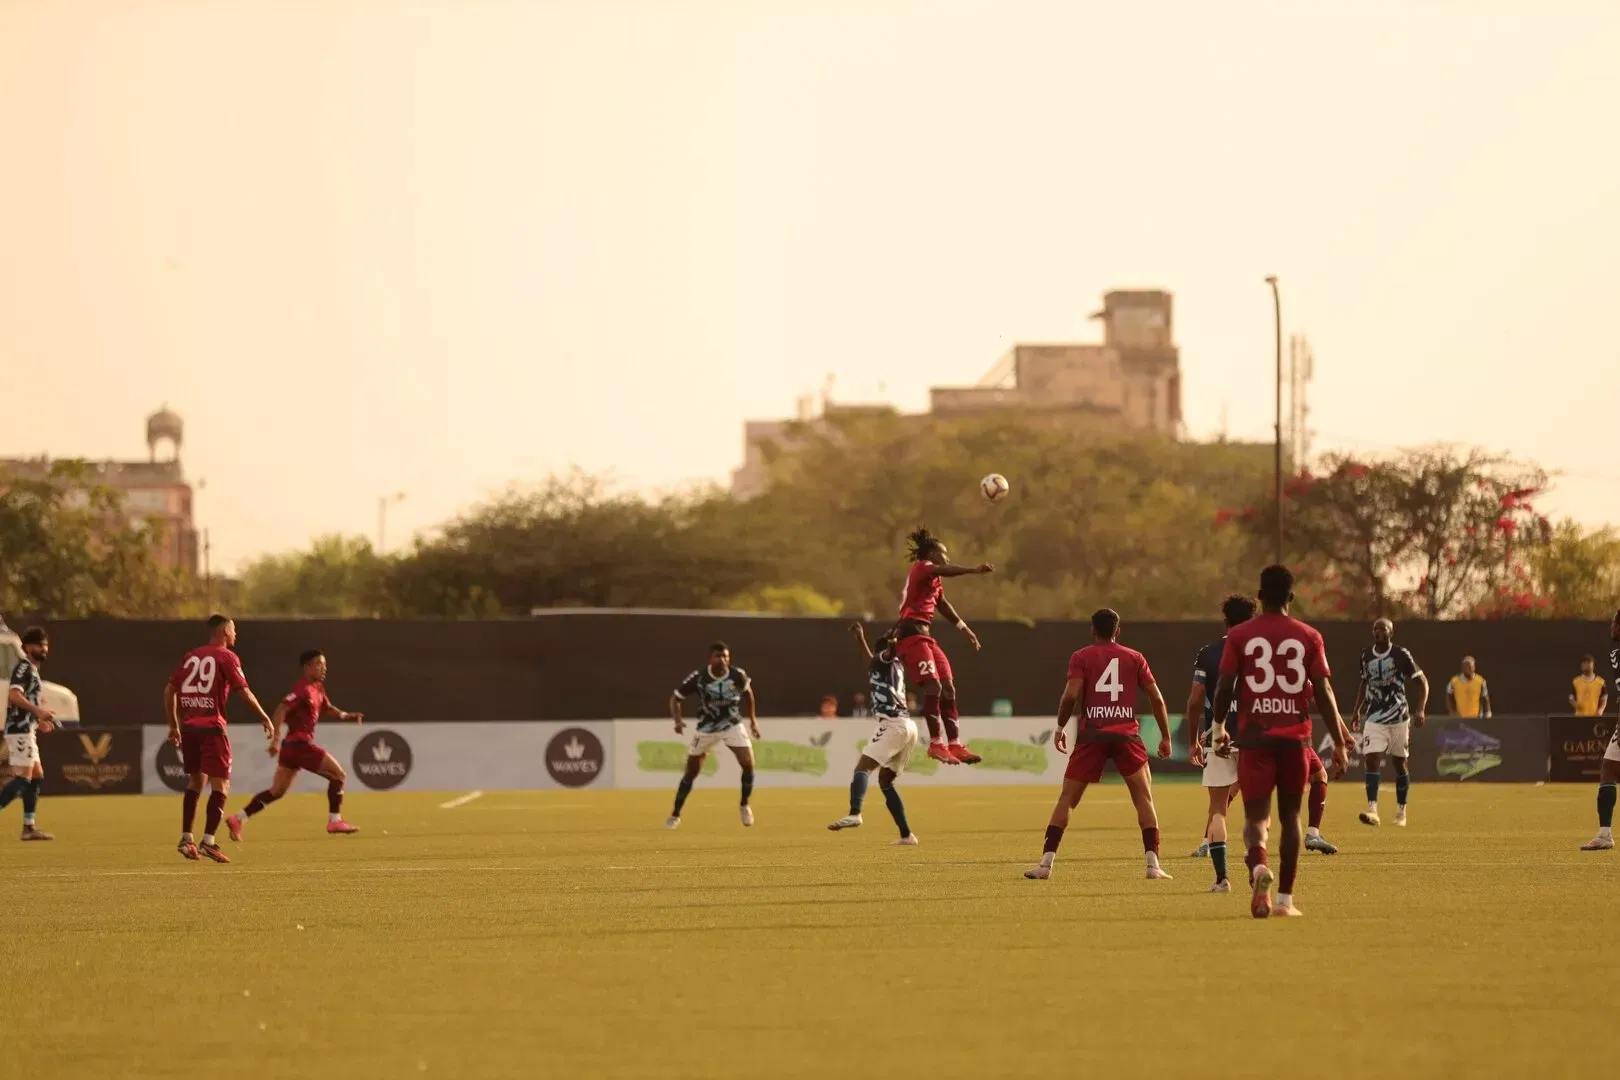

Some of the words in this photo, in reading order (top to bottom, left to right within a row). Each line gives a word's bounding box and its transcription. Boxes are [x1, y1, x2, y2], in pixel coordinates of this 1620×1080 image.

[918, 660, 936, 675] 23
[1244, 636, 1306, 694] 33
[181, 655, 216, 694] 29
[1095, 657, 1124, 702] 4
[1086, 705, 1134, 720] VIRWANI
[1251, 698, 1301, 715] ABDUL
[358, 761, 406, 776] WAVES
[551, 759, 598, 774] WAVES
